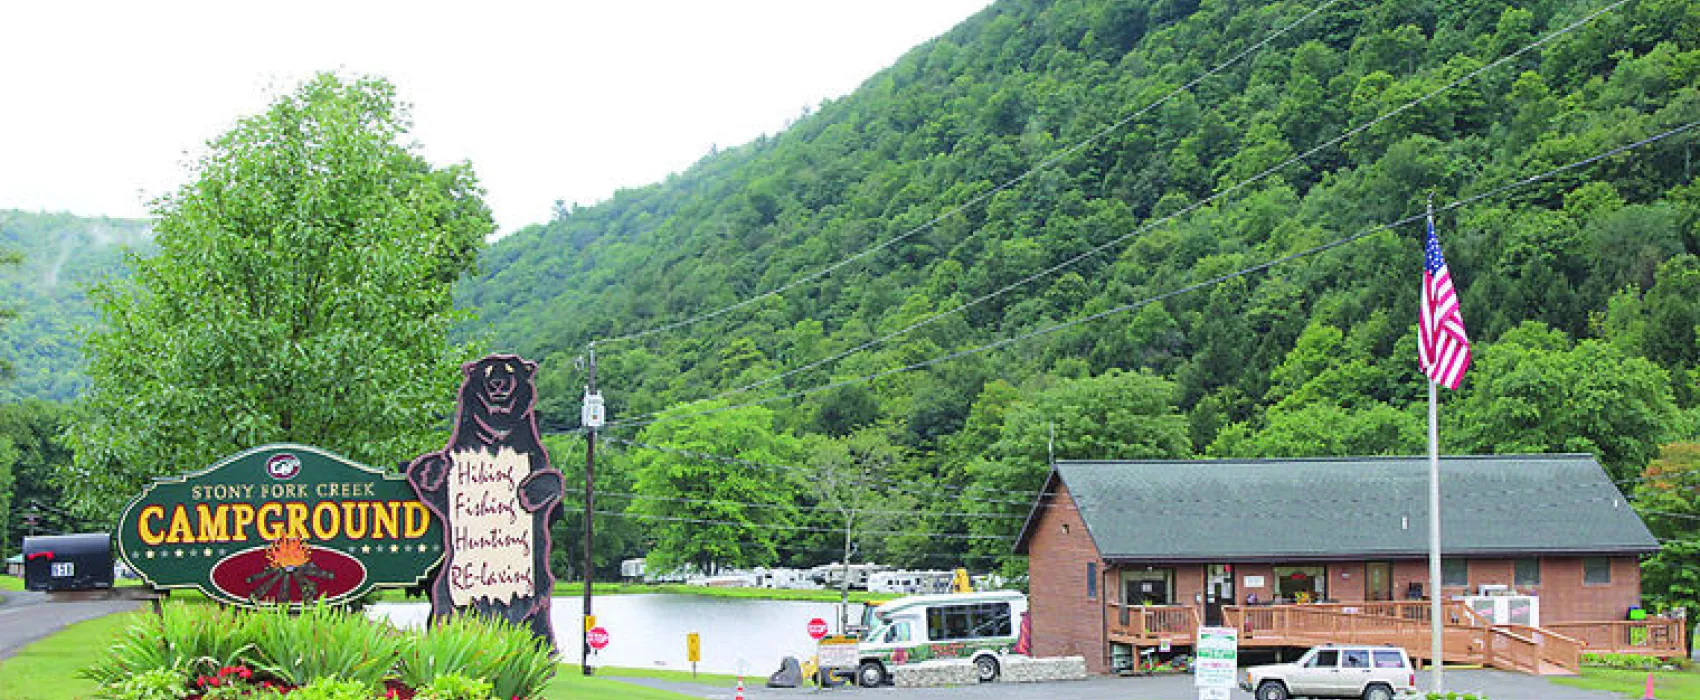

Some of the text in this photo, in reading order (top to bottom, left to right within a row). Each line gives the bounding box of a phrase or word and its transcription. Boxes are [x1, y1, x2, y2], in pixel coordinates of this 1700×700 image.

[191, 482, 375, 500] STONY FORK CREEK
[458, 461, 515, 491] Hiking
[137, 500, 431, 545] CAMPGROUND
[455, 491, 517, 525] Fishing
[455, 526, 530, 557] Hunting
